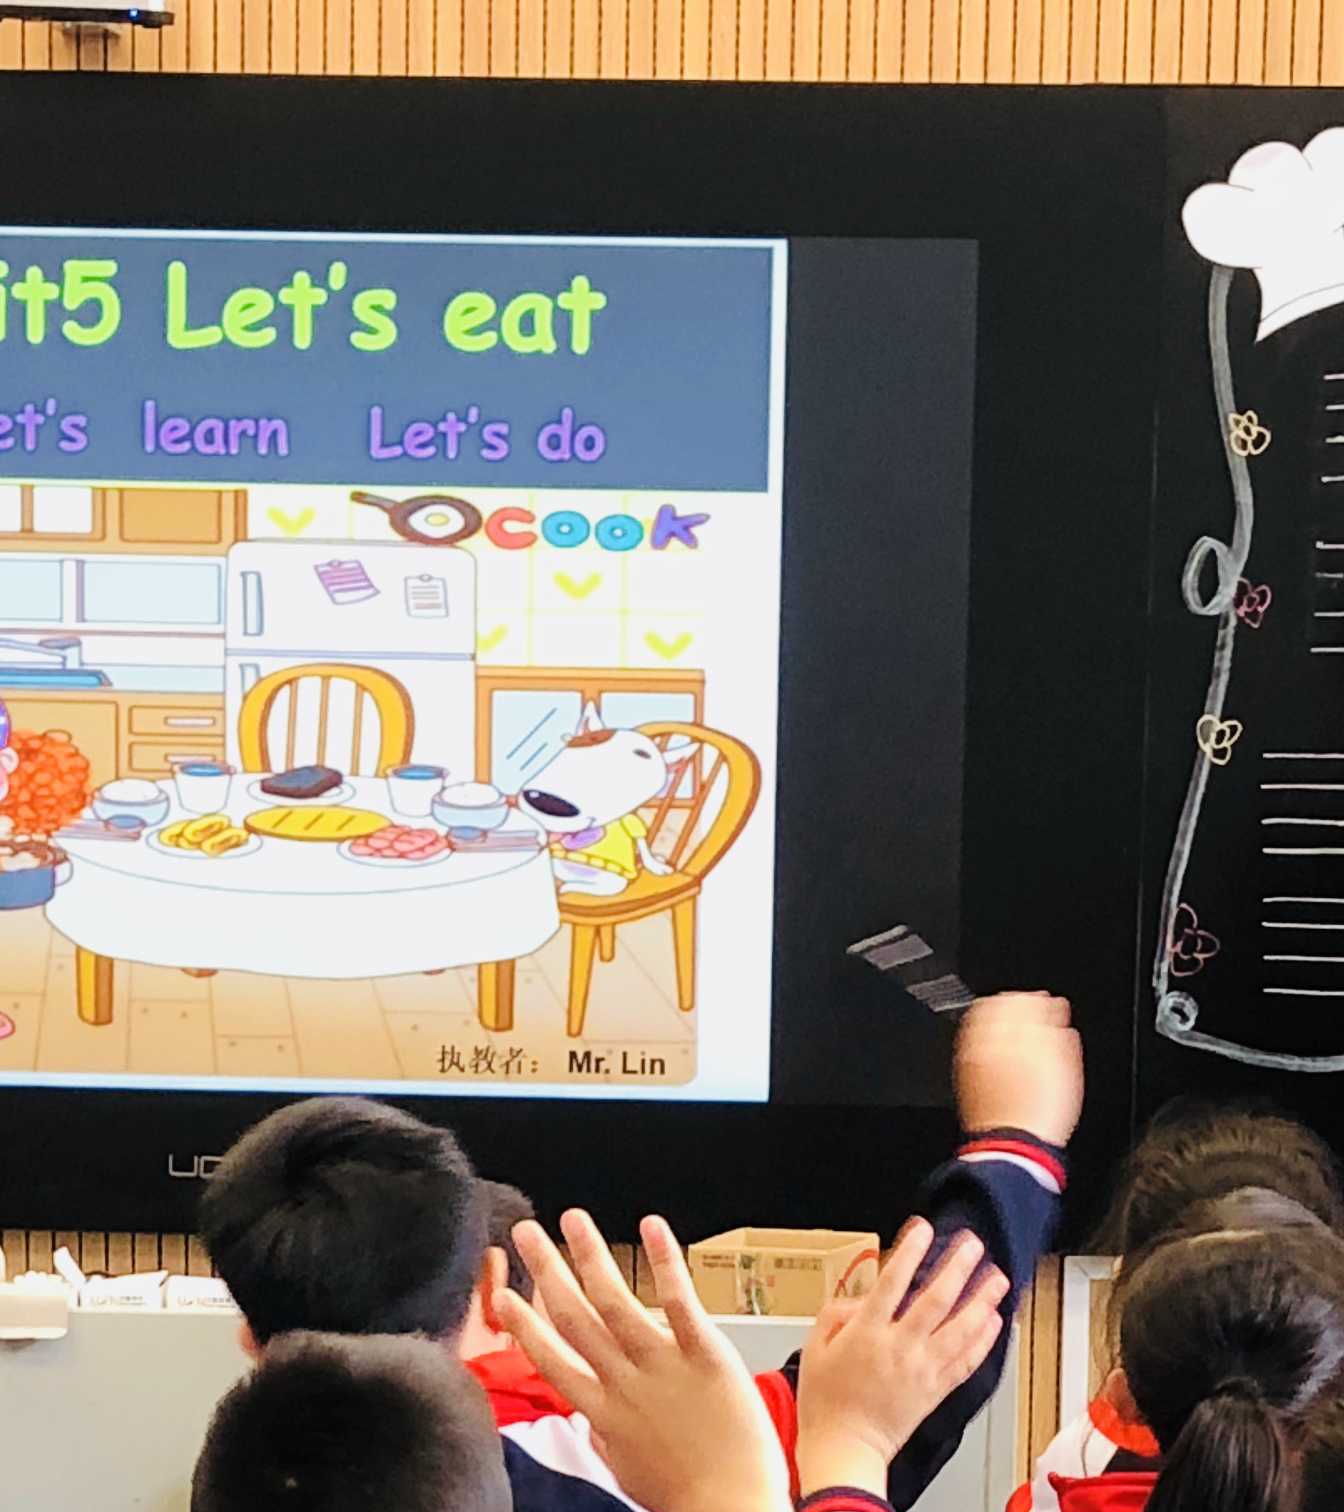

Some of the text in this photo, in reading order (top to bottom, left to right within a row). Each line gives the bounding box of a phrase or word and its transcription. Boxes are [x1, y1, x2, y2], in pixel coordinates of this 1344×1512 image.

[166, 260, 399, 352] Let's
[443, 275, 608, 355] eat
[142, 398, 291, 457] learn
[368, 404, 511, 461] Let's
[536, 406, 607, 463] do
[567, 1050, 611, 1075] Mr.
[621, 1051, 666, 1076] Lin
